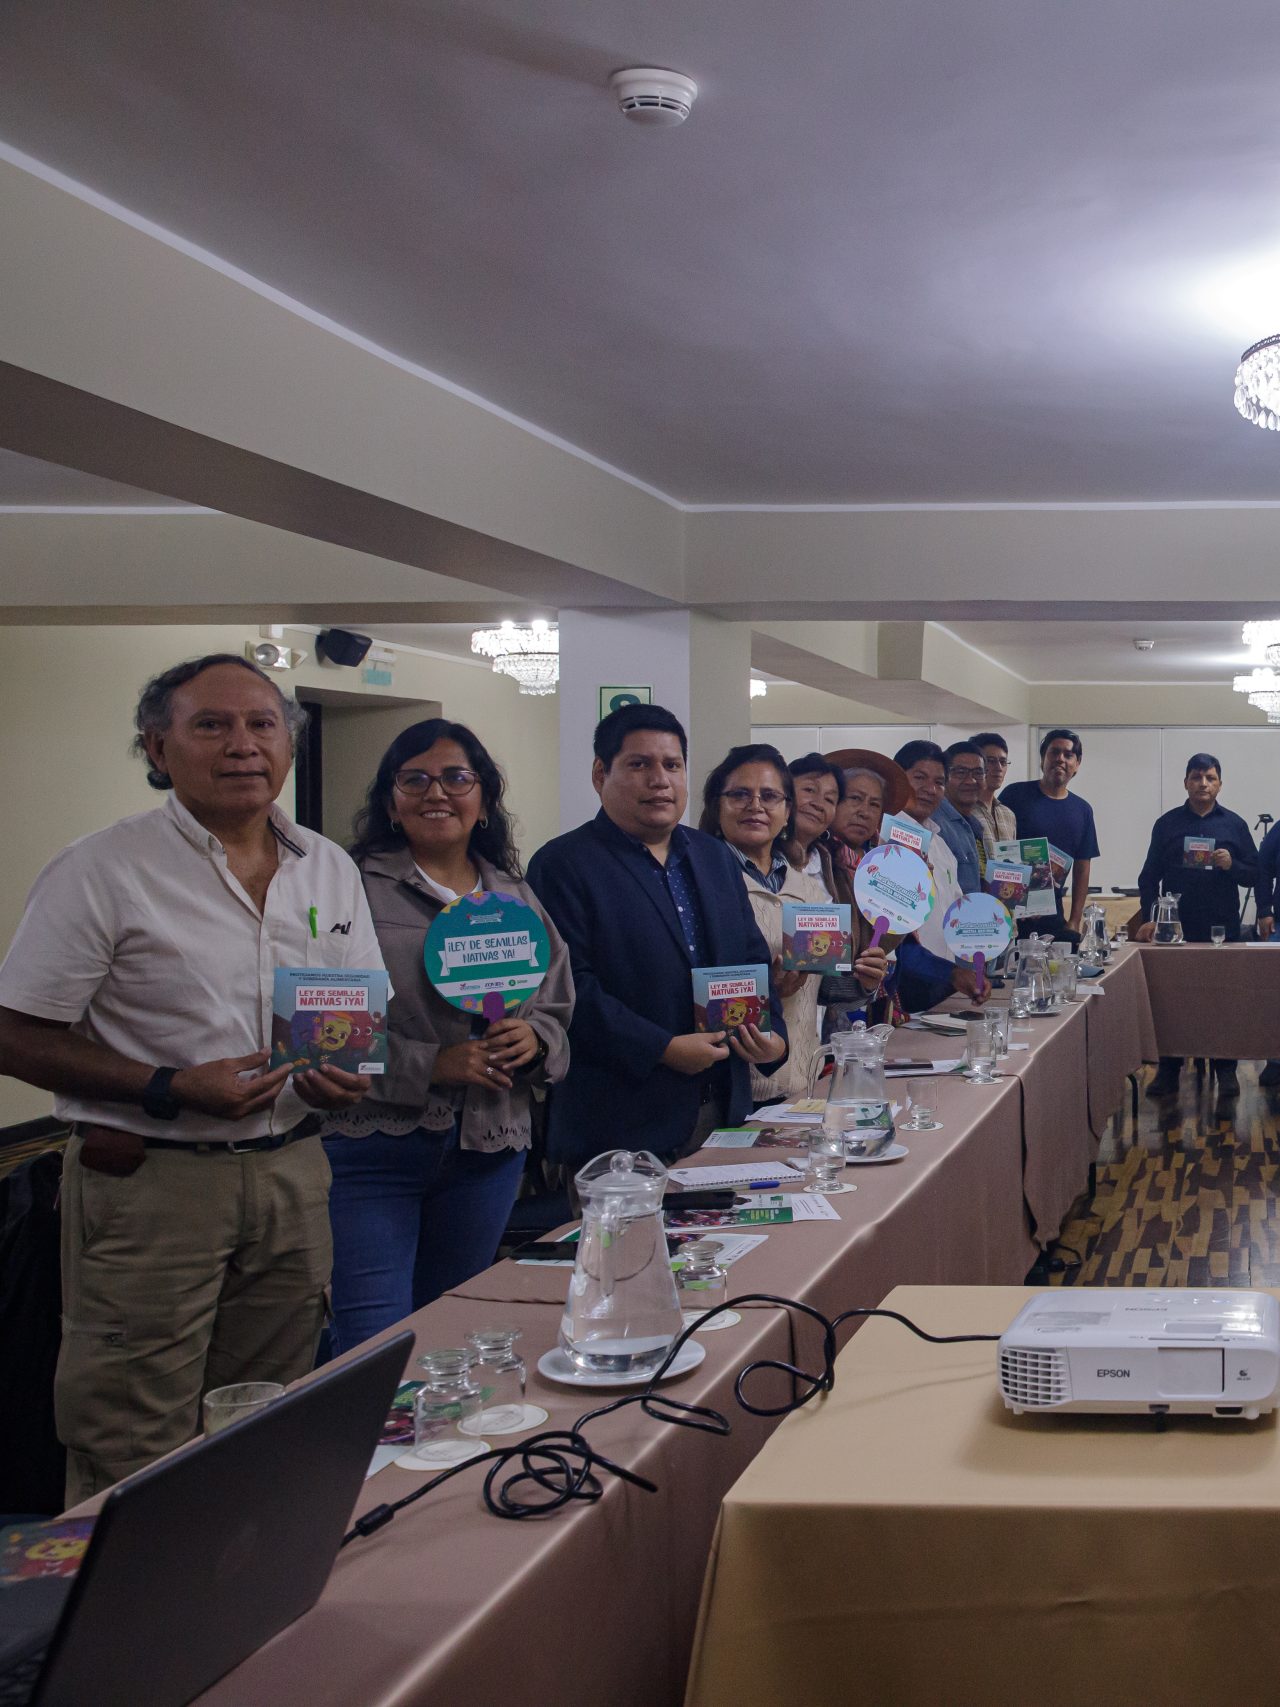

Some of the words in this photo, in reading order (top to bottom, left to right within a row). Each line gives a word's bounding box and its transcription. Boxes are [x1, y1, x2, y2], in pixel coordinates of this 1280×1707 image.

[448, 942, 466, 952] ¡LEY
[470, 940, 480, 950] DE
[485, 936, 528, 948] SEMILLAS
[463, 950, 498, 963] NATIVAS
[502, 949, 515, 959] YA!
[712, 987, 739, 996] NATIVAS
[300, 998, 341, 1006] NATIVAS
[345, 998, 364, 1006] ¡YA!
[1097, 1369, 1130, 1378] EPSON
